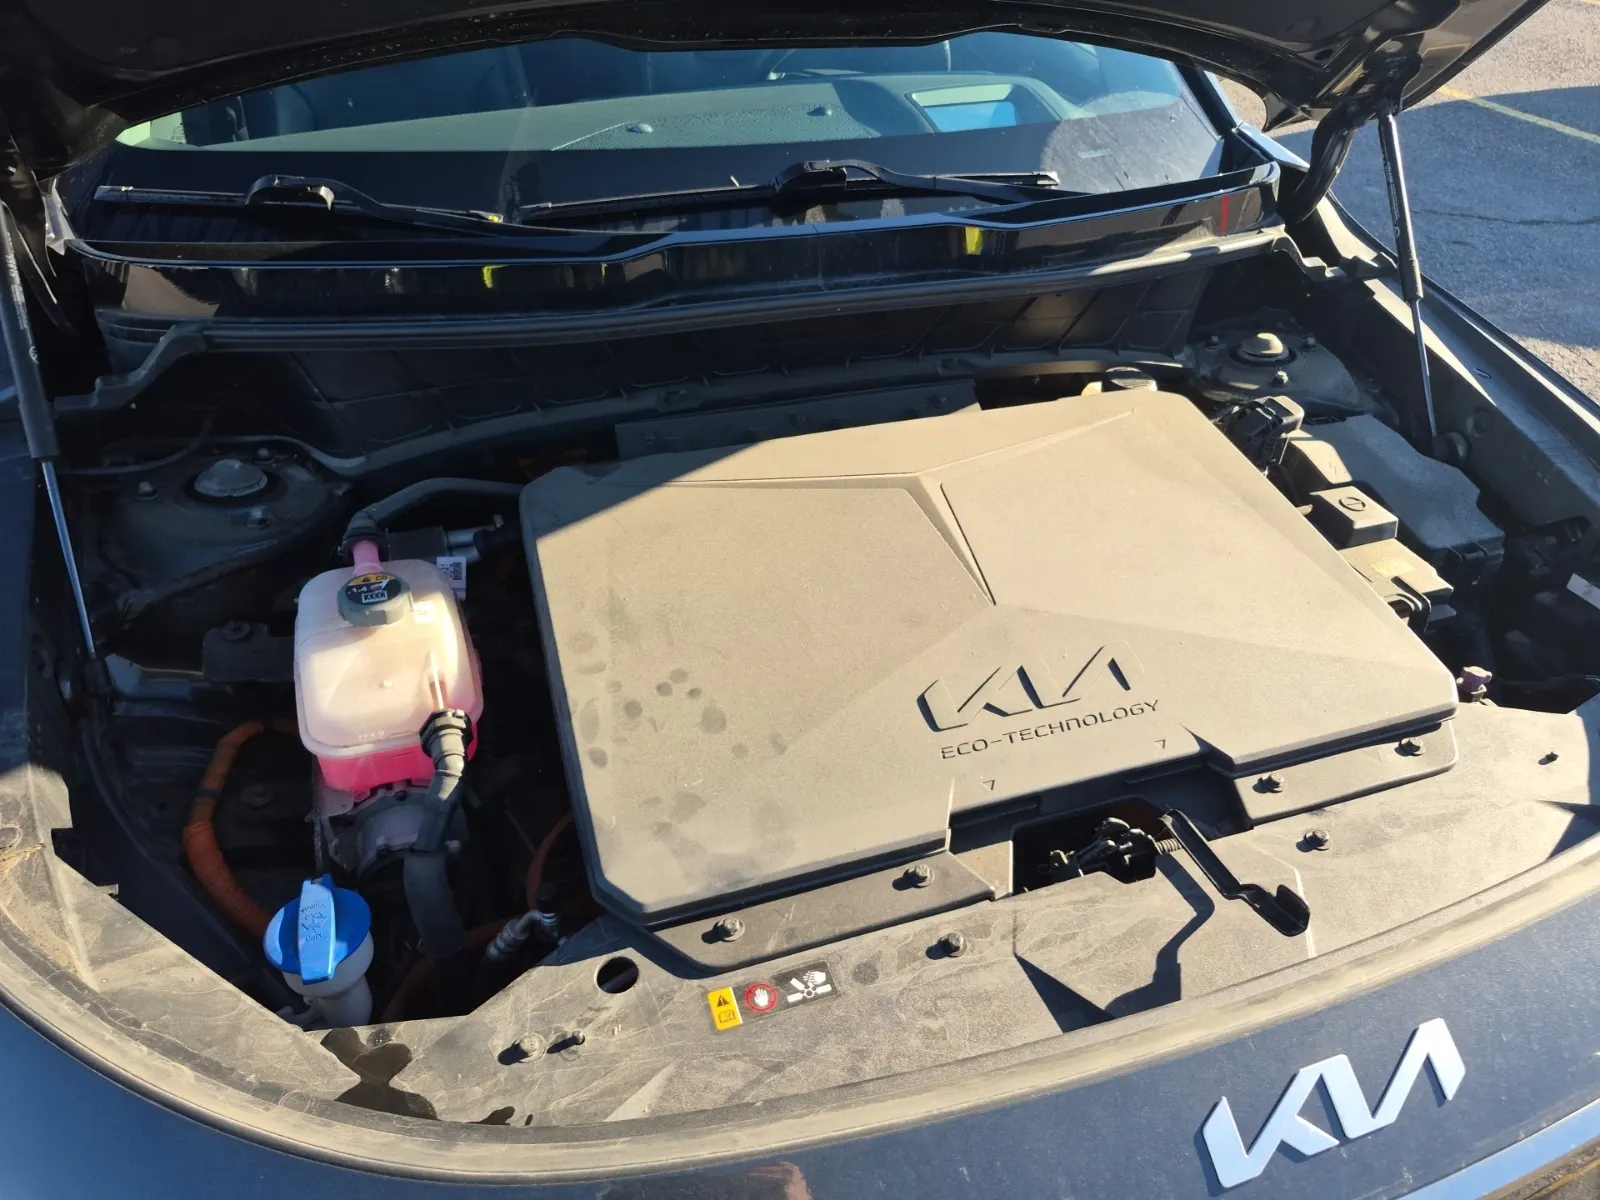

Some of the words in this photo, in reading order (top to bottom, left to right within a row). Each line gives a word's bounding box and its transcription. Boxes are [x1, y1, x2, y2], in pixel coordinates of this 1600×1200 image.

[916, 639, 1145, 732] KIA
[940, 699, 1159, 760] ECO-TECHNOLOGY
[1202, 1017, 1466, 1188] KIA
